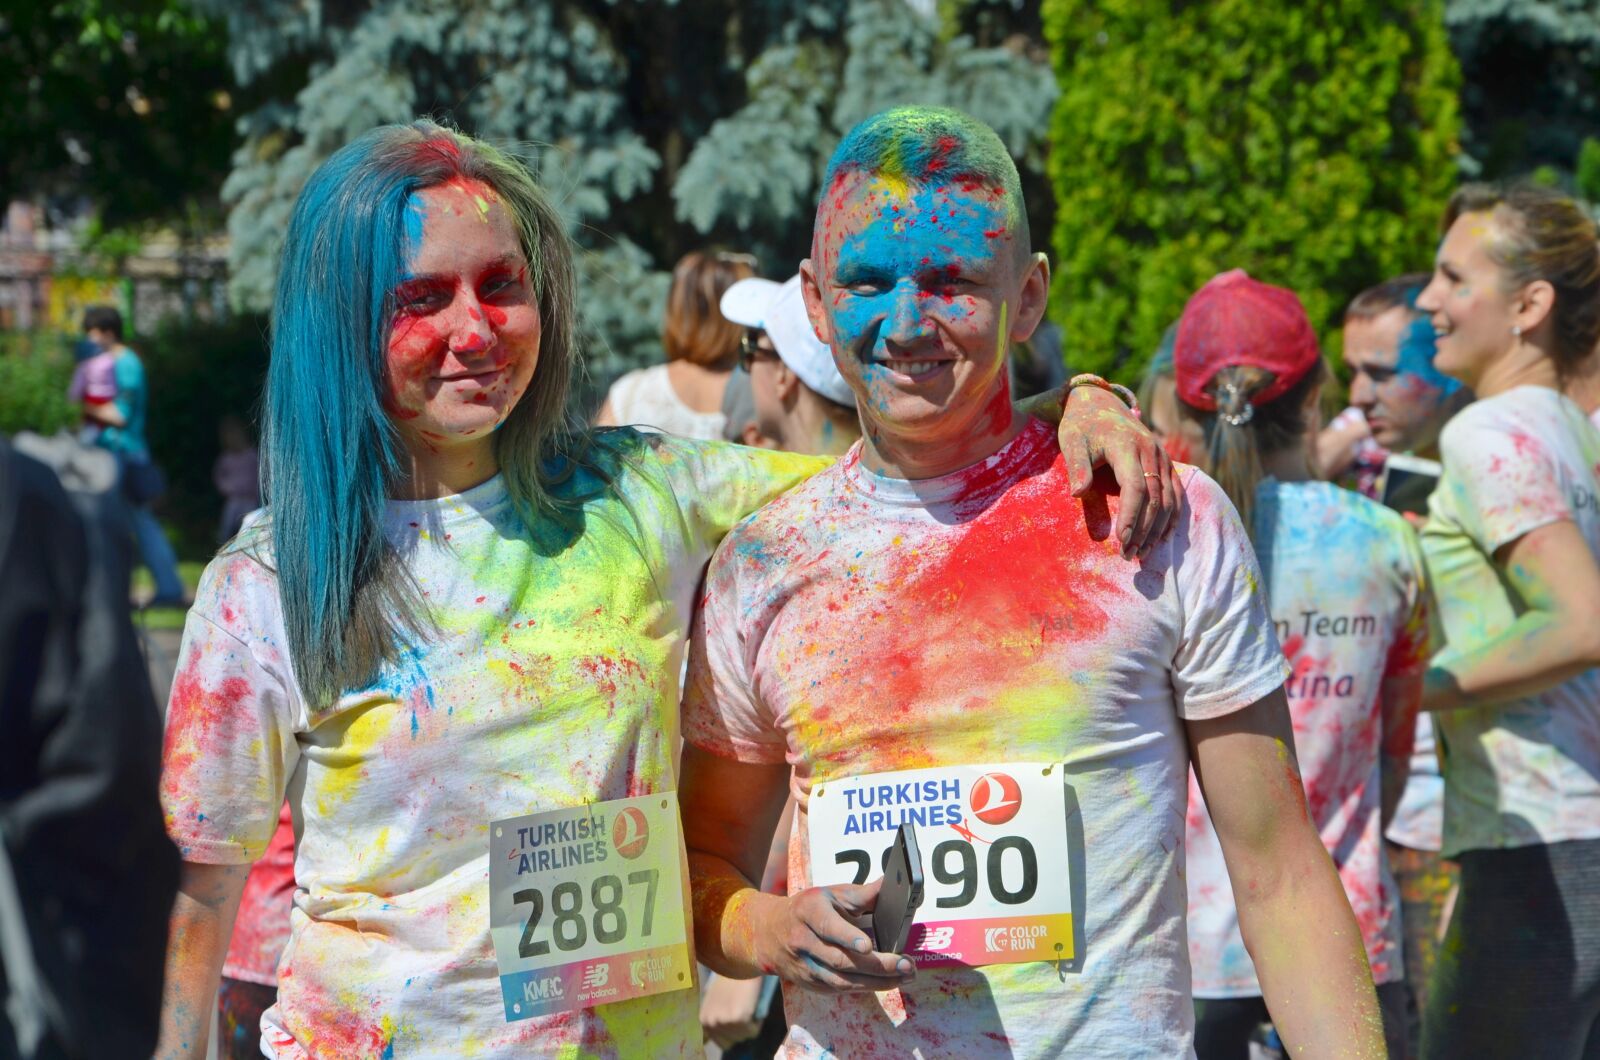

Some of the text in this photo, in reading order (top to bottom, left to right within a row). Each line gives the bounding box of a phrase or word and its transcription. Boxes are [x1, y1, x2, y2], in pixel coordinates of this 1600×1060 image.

[1300, 610, 1376, 637] Team
[843, 779, 961, 810] TURKISH
[517, 815, 606, 850] TURKISH
[843, 804, 963, 836] AIRLINES
[517, 840, 608, 876] AIRLINES
[835, 835, 1038, 909] 290
[513, 869, 660, 959] 2887
[1010, 925, 1048, 939] COLOR
[1011, 938, 1036, 951] RUN
[924, 952, 963, 961] balance
[577, 991, 590, 1001] new
[591, 986, 617, 999] balance
